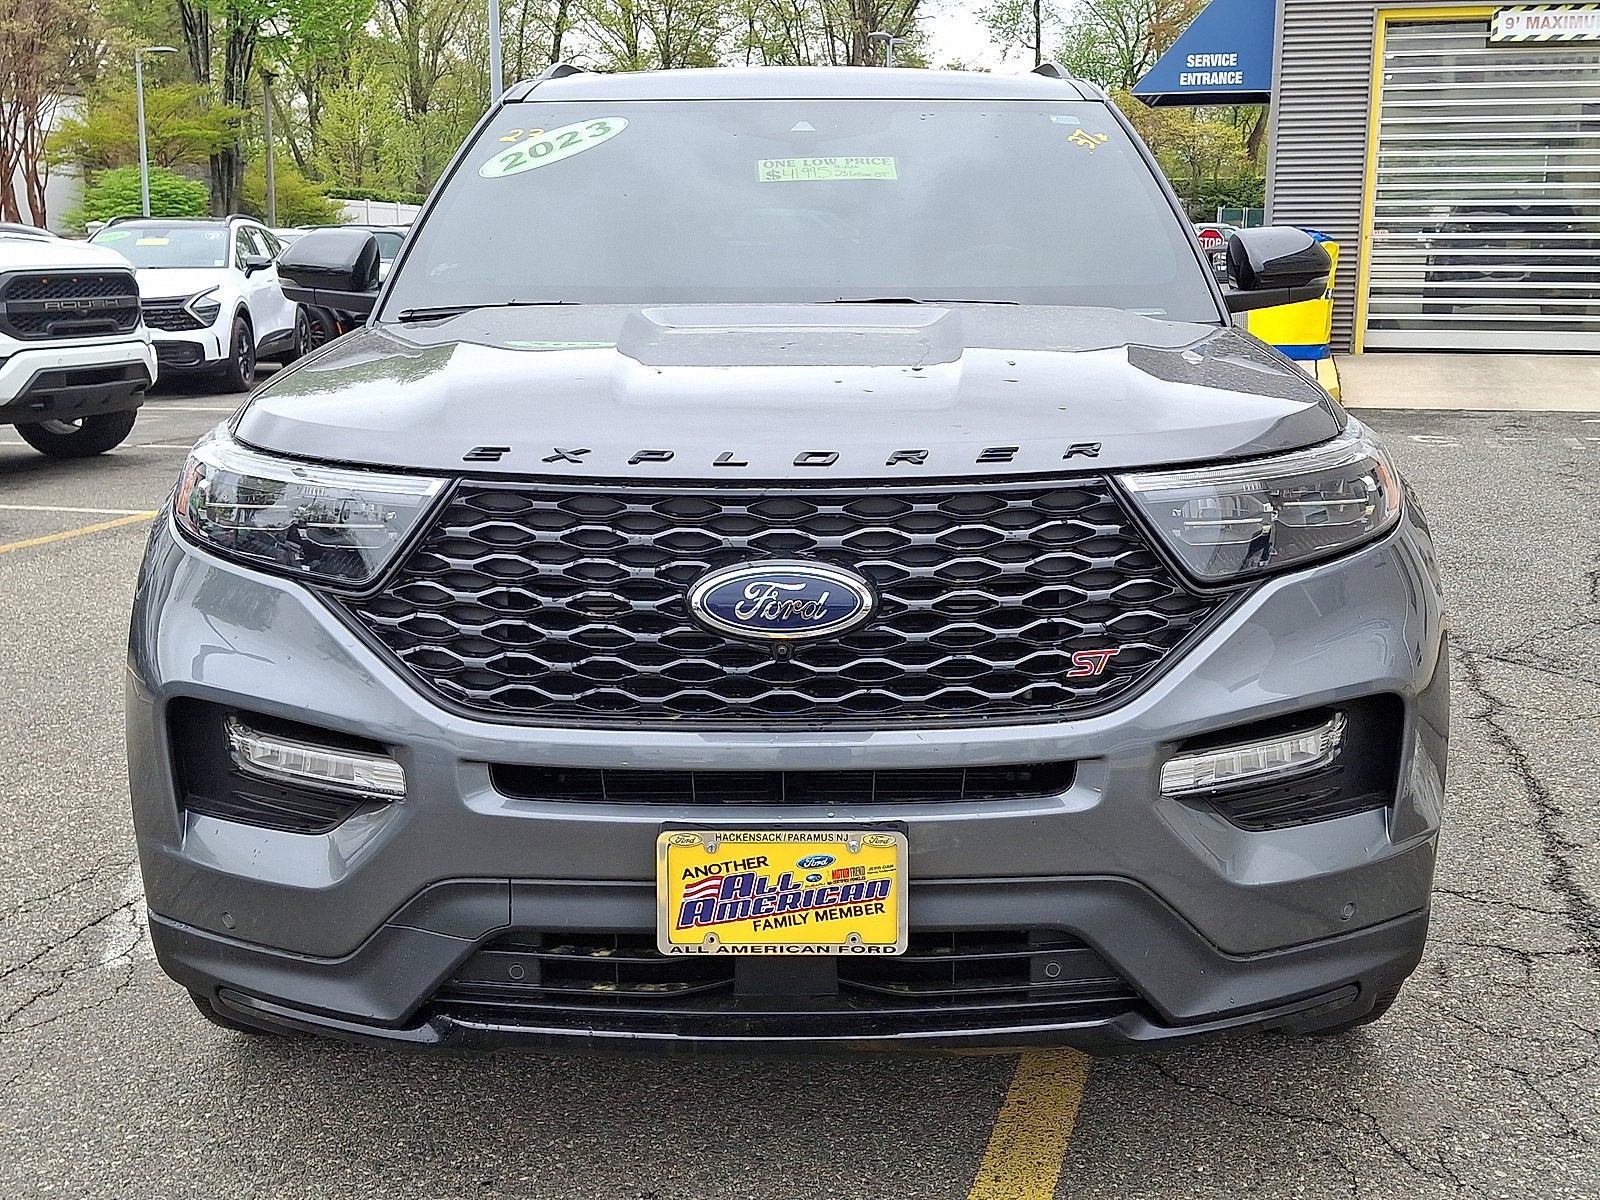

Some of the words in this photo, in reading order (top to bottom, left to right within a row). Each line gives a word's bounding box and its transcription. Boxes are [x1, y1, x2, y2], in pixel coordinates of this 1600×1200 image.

[1526, 15, 1600, 29] MAXIMU
[1187, 53, 1238, 68] SERVICE
[1180, 71, 1243, 86] ENTRANCE
[500, 121, 611, 171] 2023
[763, 159, 796, 169] ONE
[803, 158, 837, 167] LOW
[845, 157, 891, 166] PRICE
[461, 441, 1104, 467] EXPLORER
[735, 581, 830, 621] Ford
[1066, 649, 1121, 678] ST
[674, 834, 696, 844] Ford
[715, 832, 835, 842] HACKENSACK/PARAMUS
[836, 833, 849, 842] NJ
[869, 835, 889, 845] Ford
[681, 855, 769, 880] ANOTHER
[803, 856, 829, 868] Ford
[677, 878, 892, 929] AMERICAN
[753, 913, 809, 932] FAMILY
[815, 902, 885, 923] MEMBER
[670, 945, 710, 954] ALL
[716, 945, 836, 954] AMERICAN
[839, 945, 896, 954] FORD
